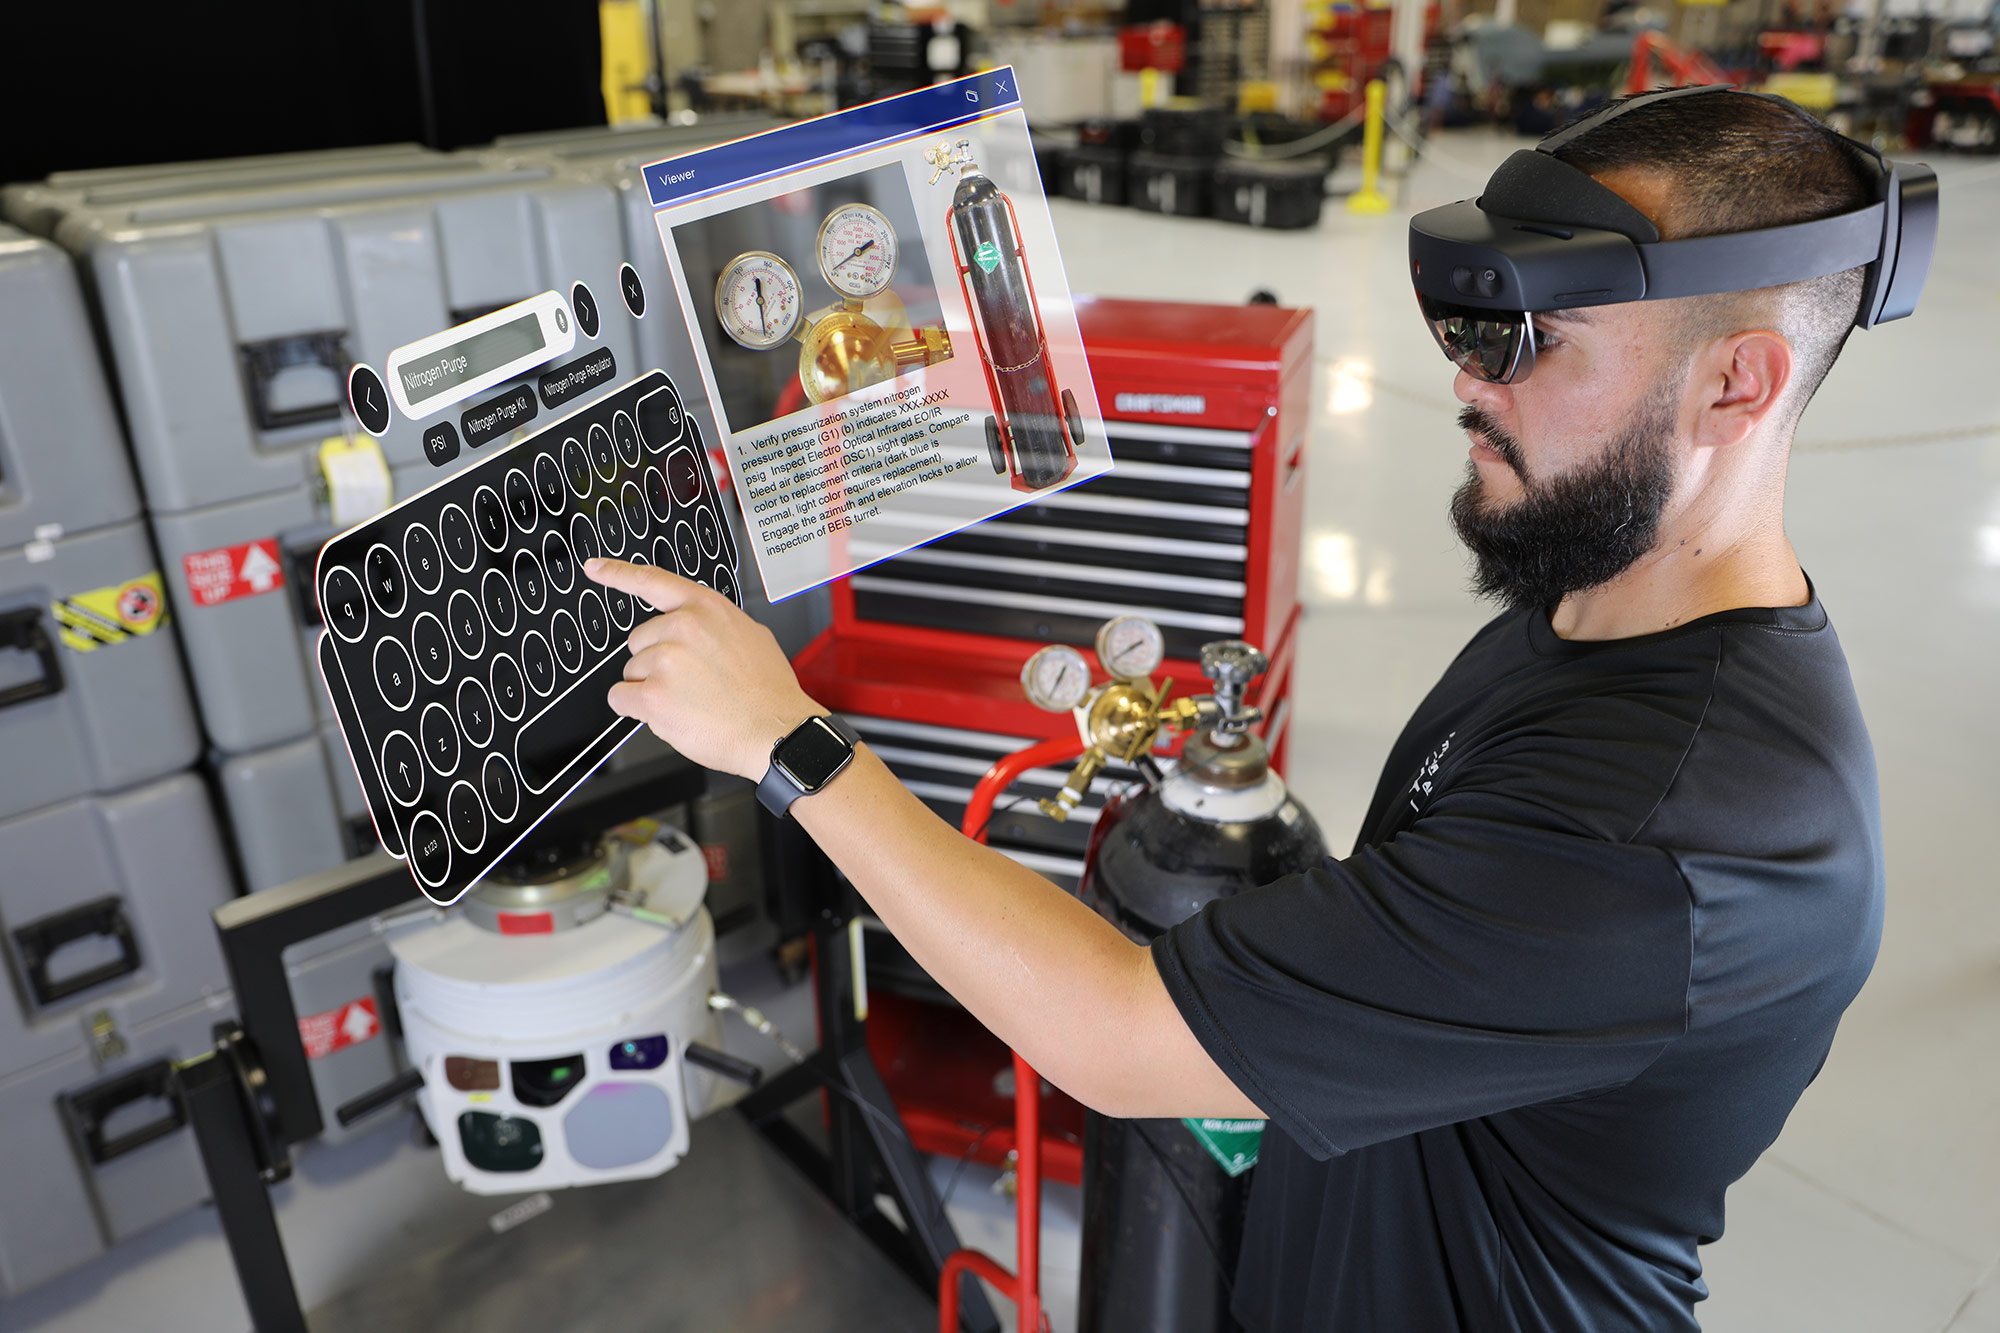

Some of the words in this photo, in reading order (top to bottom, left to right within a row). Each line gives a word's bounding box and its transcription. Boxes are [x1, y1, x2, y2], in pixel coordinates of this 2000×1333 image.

[659, 170, 695, 186] Viewer
[734, 266, 744, 275] 120
[404, 366, 441, 391] Nitrogen
[441, 354, 468, 379] Purge
[543, 378, 570, 398] Nitrogen
[570, 367, 587, 385] Purge
[586, 356, 612, 378] Regulator
[431, 435, 446, 452] PSI
[467, 412, 498, 435] Nitrogen
[497, 402, 517, 422] Purge
[517, 397, 528, 411] Kit
[737, 446, 747, 456] 1.
[751, 434, 779, 450] Verify
[781, 412, 847, 442] pressurization
[849, 400, 882, 417] system
[884, 386, 921, 404] nitrogen
[741, 449, 784, 472] pressure
[785, 438, 816, 457] gauge
[818, 428, 839, 445] (G1)
[841, 423, 855, 436] (b)
[856, 409, 897, 429] indicates
[899, 389, 950, 414] XXX-XXXX
[746, 472, 767, 487] psig
[771, 456, 807, 475] Inspect
[808, 445, 840, 462] Electro
[843, 430, 875, 449] Optical
[878, 418, 912, 437] Infrared
[914, 406, 942, 424] EO/IR
[749, 482, 776, 499] bleed
[779, 477, 791, 489] air
[794, 460, 838, 483] desiccant
[840, 447, 875, 468] (DSC1)
[877, 438, 899, 453] sight
[901, 430, 927, 446] glass.
[929, 413, 970, 433] Compare
[754, 498, 778, 513] color
[780, 494, 789, 504] to
[791, 472, 849, 500] replacement
[852, 460, 883, 477] criteria
[885, 450, 908, 467] (dark
[909, 443, 929, 456] blue
[931, 439, 939, 448] is
[758, 508, 794, 527] normal,
[796, 500, 817, 514] light
[818, 491, 841, 505] color
[843, 476, 881, 496] requires
[883, 452, 944, 481] replacement).
[345, 603, 354, 619] q
[383, 579, 392, 593] w
[422, 558, 429, 570] e
[458, 538, 462, 549] r
[489, 516, 495, 529] t
[520, 500, 526, 515] y
[548, 484, 554, 494] u
[575, 465, 581, 477] i
[601, 453, 606, 462] o
[625, 439, 630, 451] p
[762, 521, 799, 542] Engage
[801, 516, 817, 527] the
[820, 501, 855, 520] azimuth
[858, 492, 875, 506] and
[877, 478, 918, 499] elevation
[919, 468, 943, 483] locks
[944, 464, 954, 473] to
[956, 455, 978, 470] allow
[766, 532, 814, 556] inspection
[817, 526, 826, 536] of
[828, 516, 852, 533] BEIS
[854, 506, 881, 522] turret.
[337, 578, 341, 586] 1
[377, 555, 381, 564] 2
[415, 534, 419, 542] 3
[393, 673, 401, 686] a
[431, 648, 437, 660] s
[465, 620, 472, 635] d
[498, 598, 503, 613] f
[529, 581, 535, 596] g
[556, 560, 563, 572] h
[584, 540, 591, 558] j
[609, 524, 615, 536] k
[439, 738, 446, 751] z
[474, 711, 481, 724] x
[507, 686, 513, 697] c
[537, 662, 542, 673] v
[564, 639, 571, 651] b
[593, 620, 599, 630] n
[617, 600, 625, 611] m
[424, 840, 437, 856] &123
